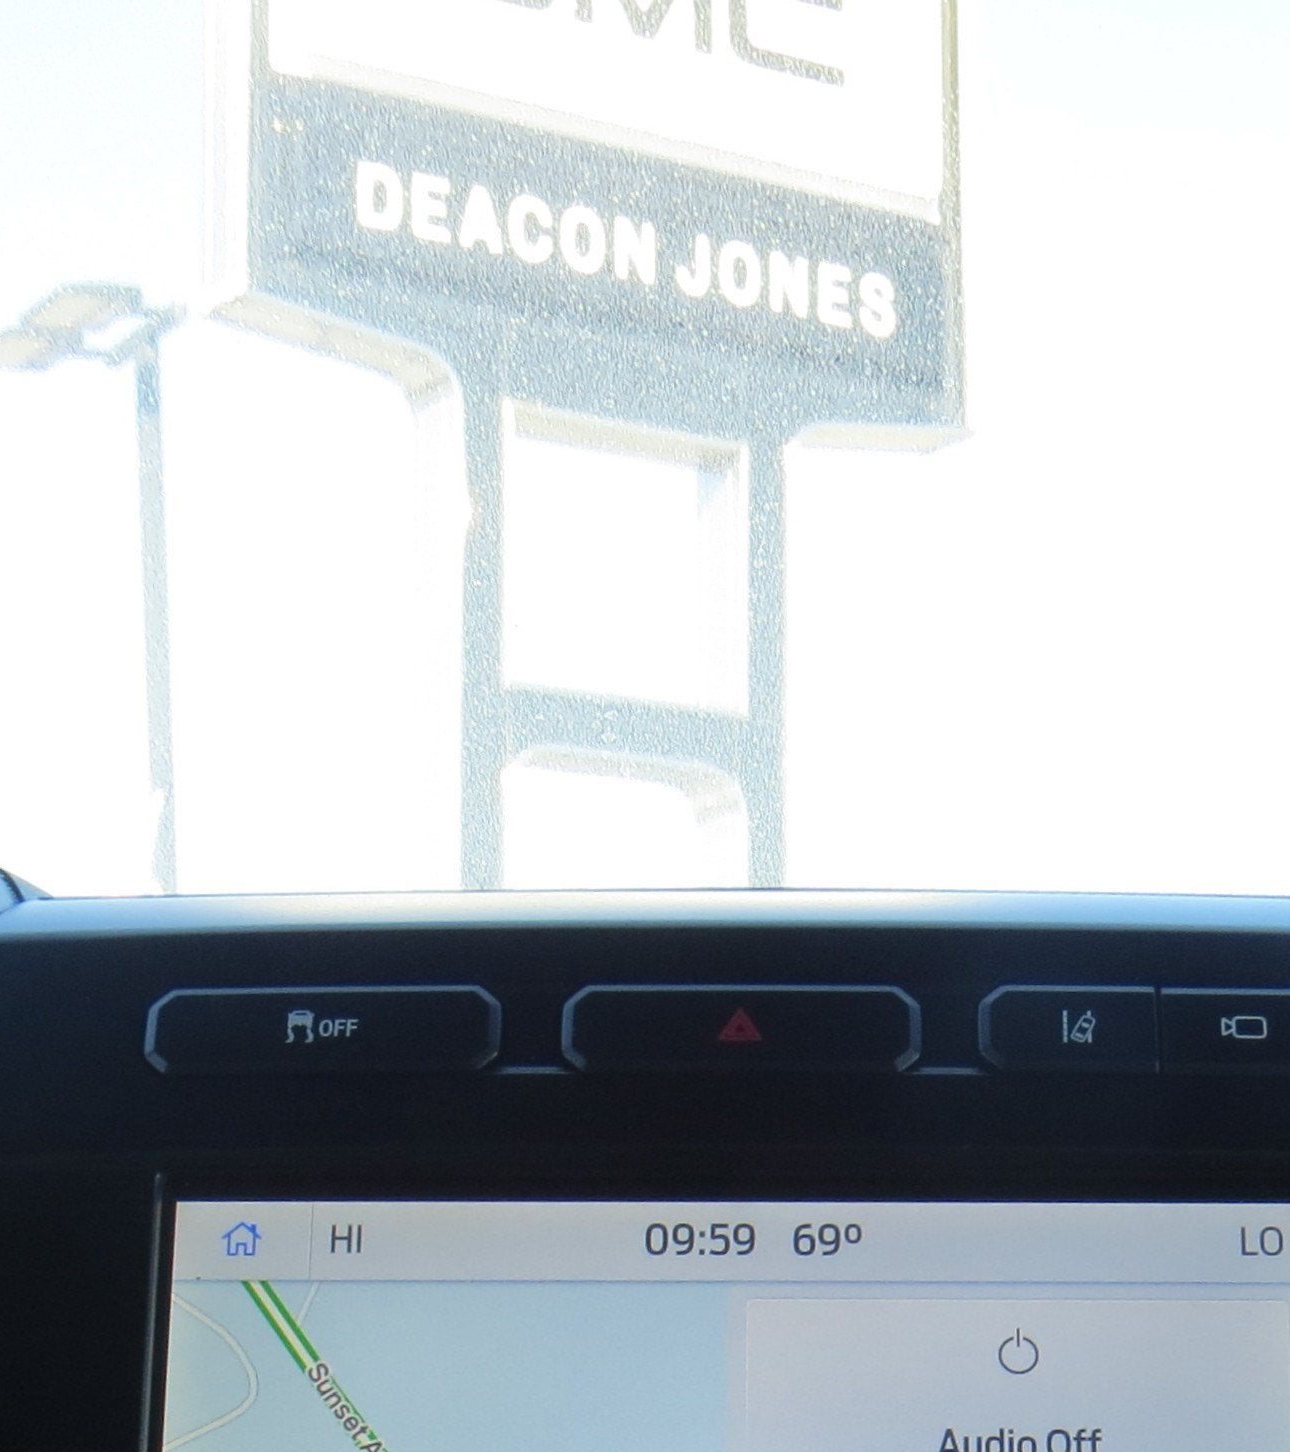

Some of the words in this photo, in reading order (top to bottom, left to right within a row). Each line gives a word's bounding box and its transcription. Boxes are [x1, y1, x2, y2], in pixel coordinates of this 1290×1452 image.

[355, 160, 657, 286] DEACON
[674, 232, 898, 339] JONES
[318, 1018, 359, 1038] OFF
[329, 1224, 364, 1254] HI
[644, 1222, 756, 1256] 09:59
[1241, 1226, 1284, 1256] LO
[307, 1362, 371, 1443] Sunset
